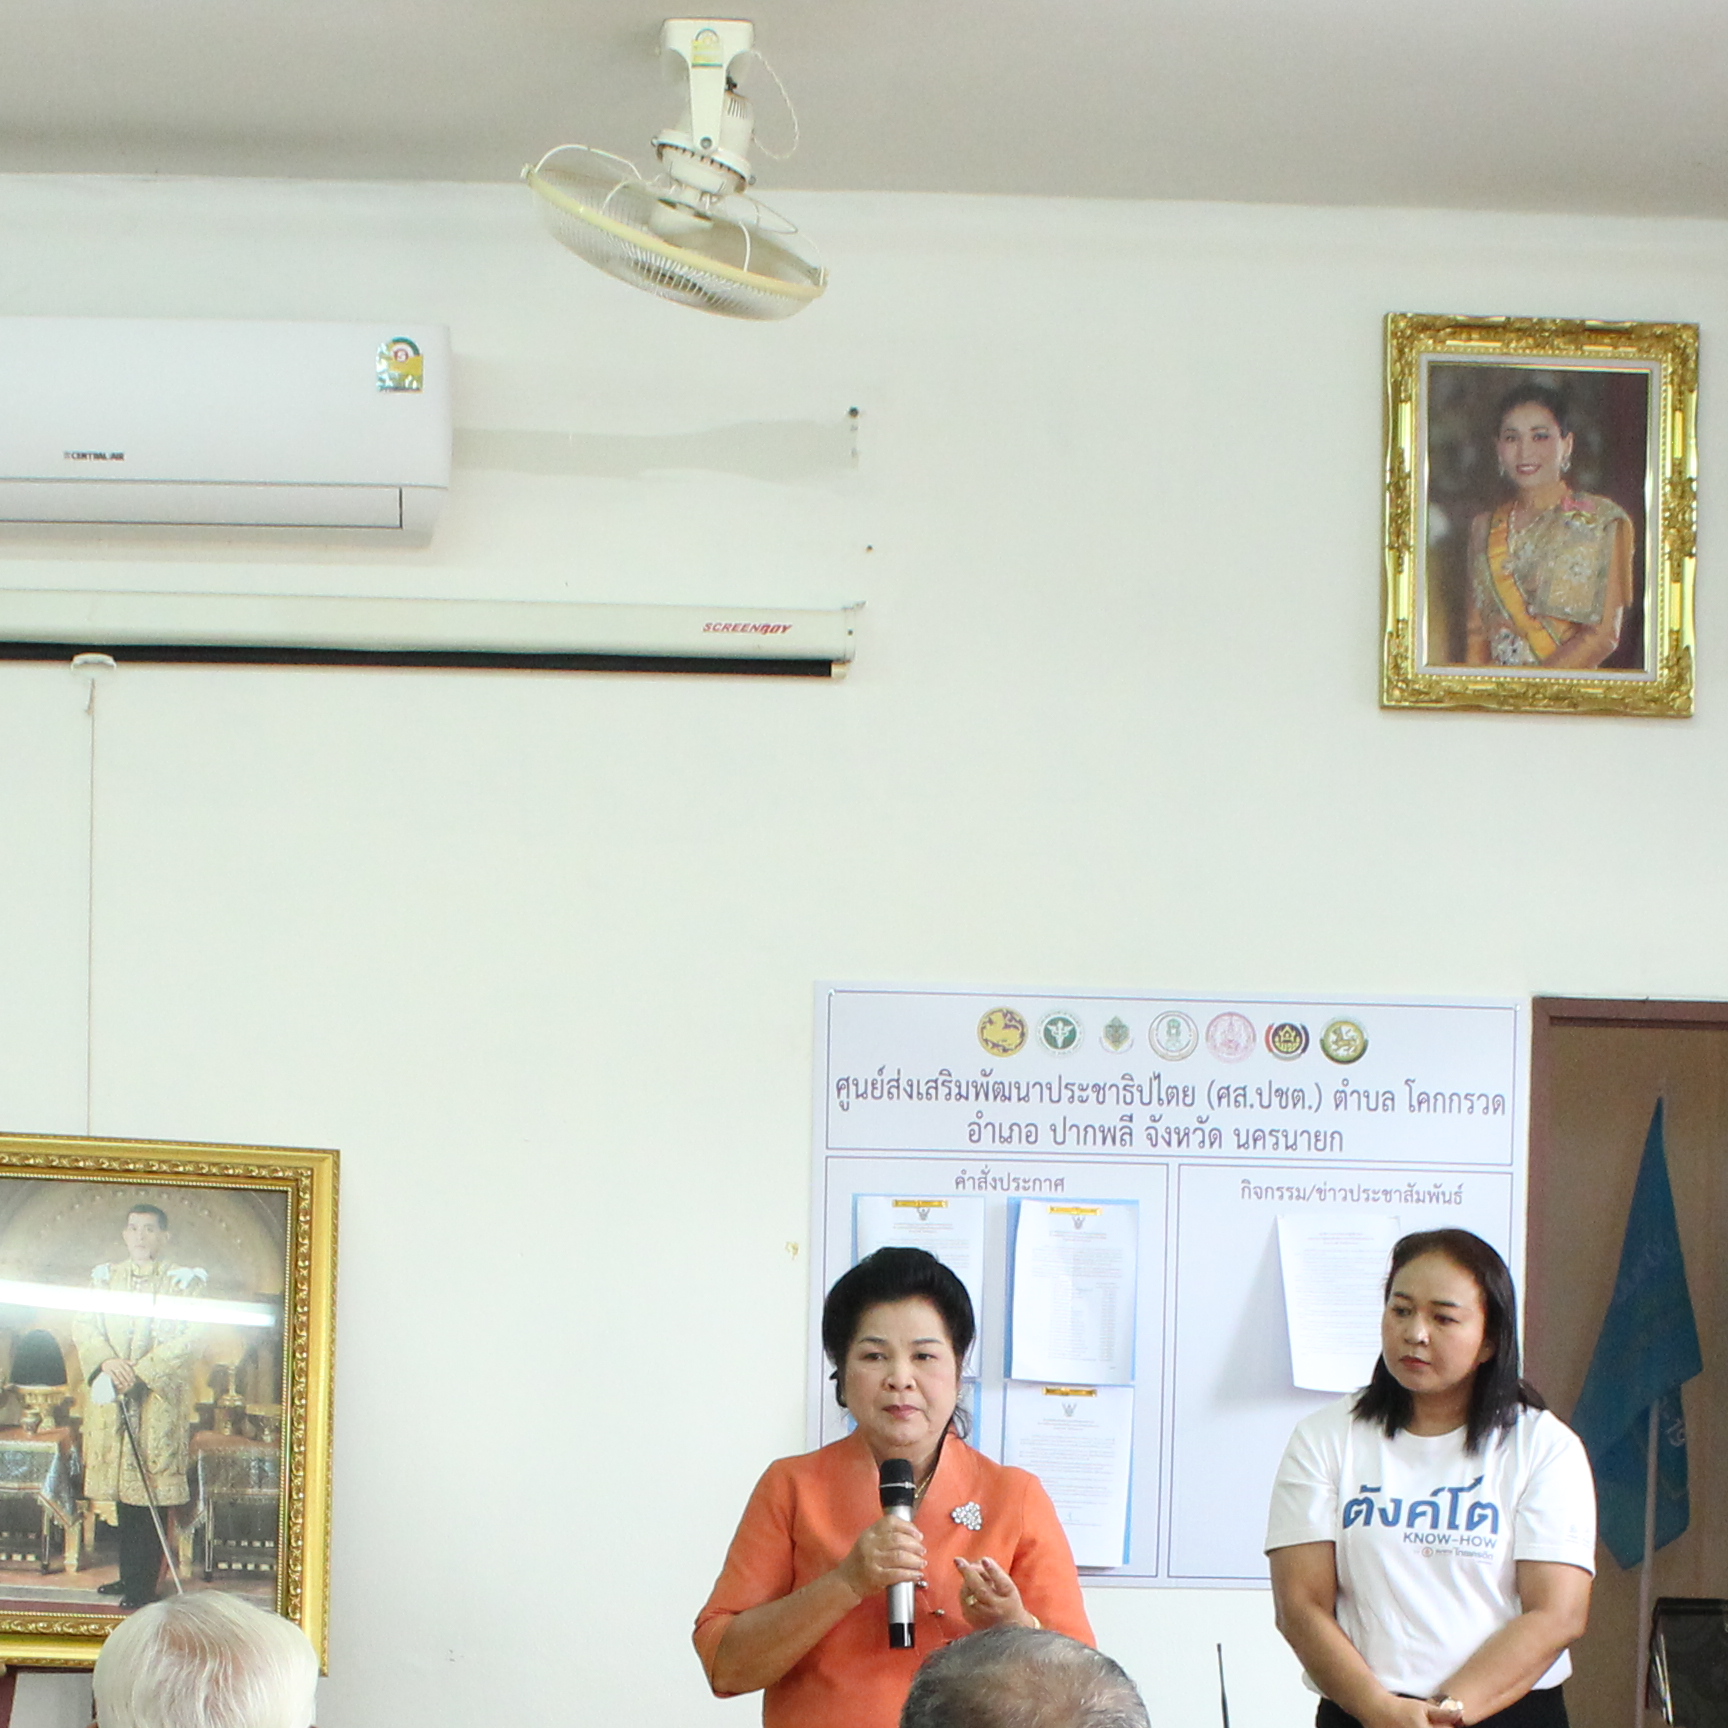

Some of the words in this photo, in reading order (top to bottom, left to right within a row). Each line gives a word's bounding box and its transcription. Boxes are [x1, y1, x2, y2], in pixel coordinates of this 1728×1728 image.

[835, 1064, 1196, 1112] ศูนย์ส่งเสริมพัฒนาประชาธิปไตย
[1206, 1078, 1323, 1114] (ศส.ปชต.)
[1333, 1078, 1396, 1113] ตำบล
[1404, 1078, 1507, 1116] โคกกรวด
[967, 1110, 1039, 1146] อำเภอ
[1049, 1112, 1134, 1148] ปากพลี
[1144, 1113, 1223, 1150] จังหวัด
[1233, 1126, 1344, 1152] นครนายก
[954, 1164, 1066, 1193] คำสั่งประกาศ
[1240, 1178, 1465, 1206] กิจกรรม/ข่าวประชาสัมพันธ์
[1342, 1474, 1500, 1535] ตังค์โต
[1402, 1532, 1498, 1549] KNOW-HOW
